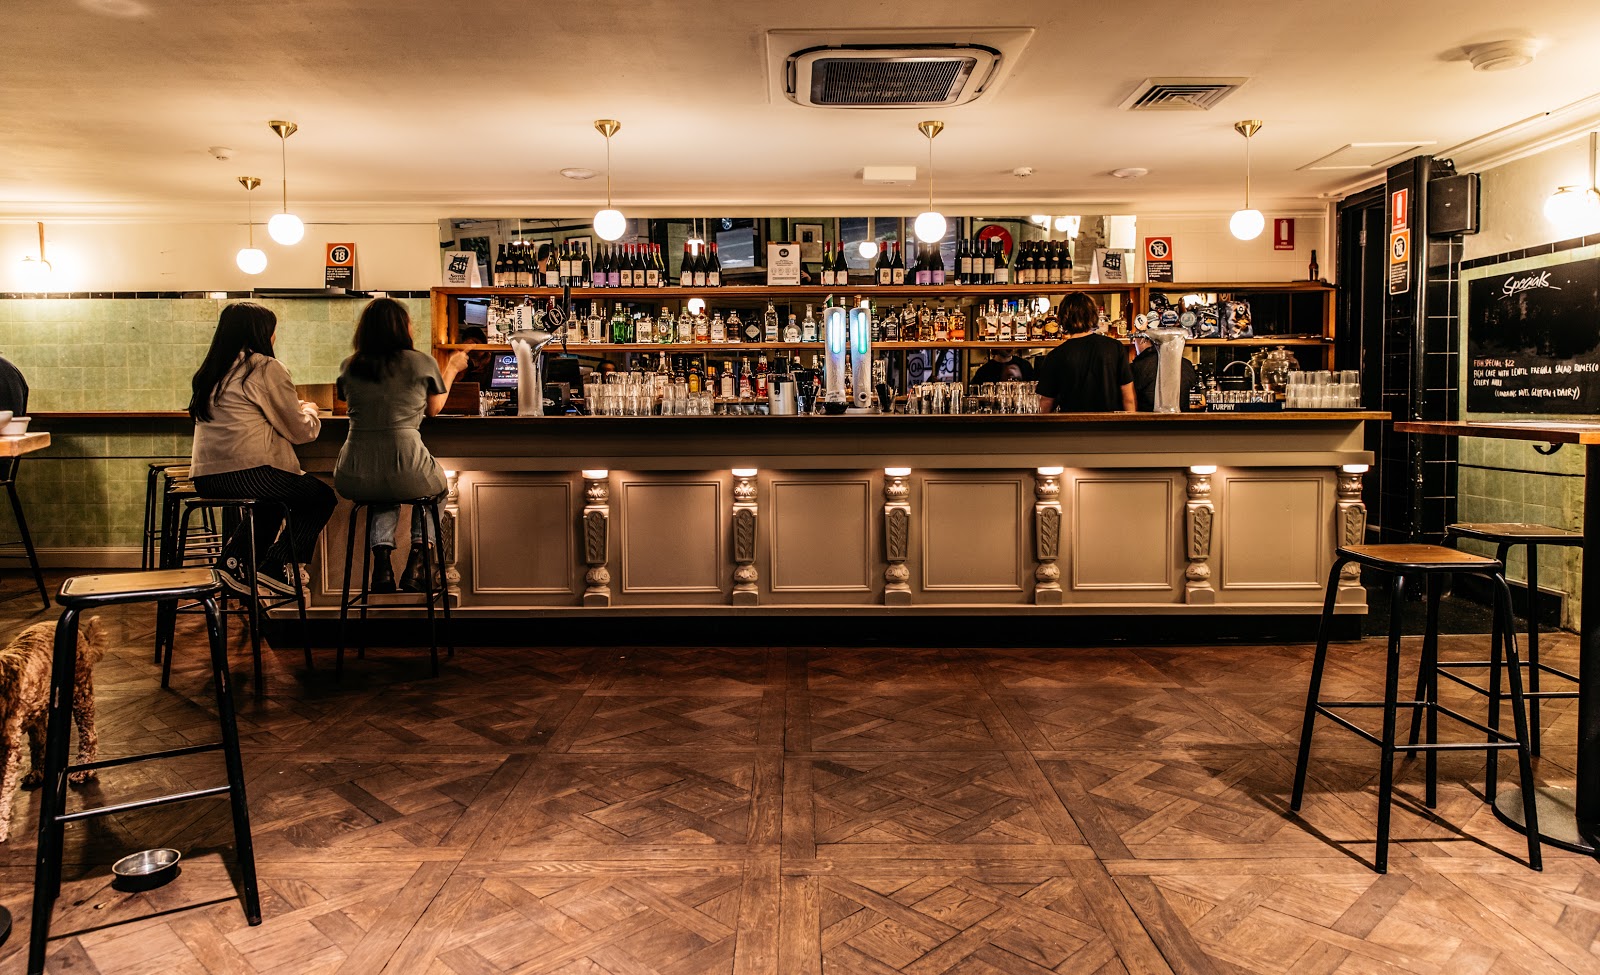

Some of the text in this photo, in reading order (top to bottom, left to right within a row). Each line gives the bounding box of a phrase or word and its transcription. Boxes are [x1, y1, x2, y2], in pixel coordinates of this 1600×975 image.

[335, 251, 346, 261] 18
[1502, 271, 1550, 296] Specials
[1505, 358, 1514, 367] $22
[1212, 403, 1235, 411] FURPHY
